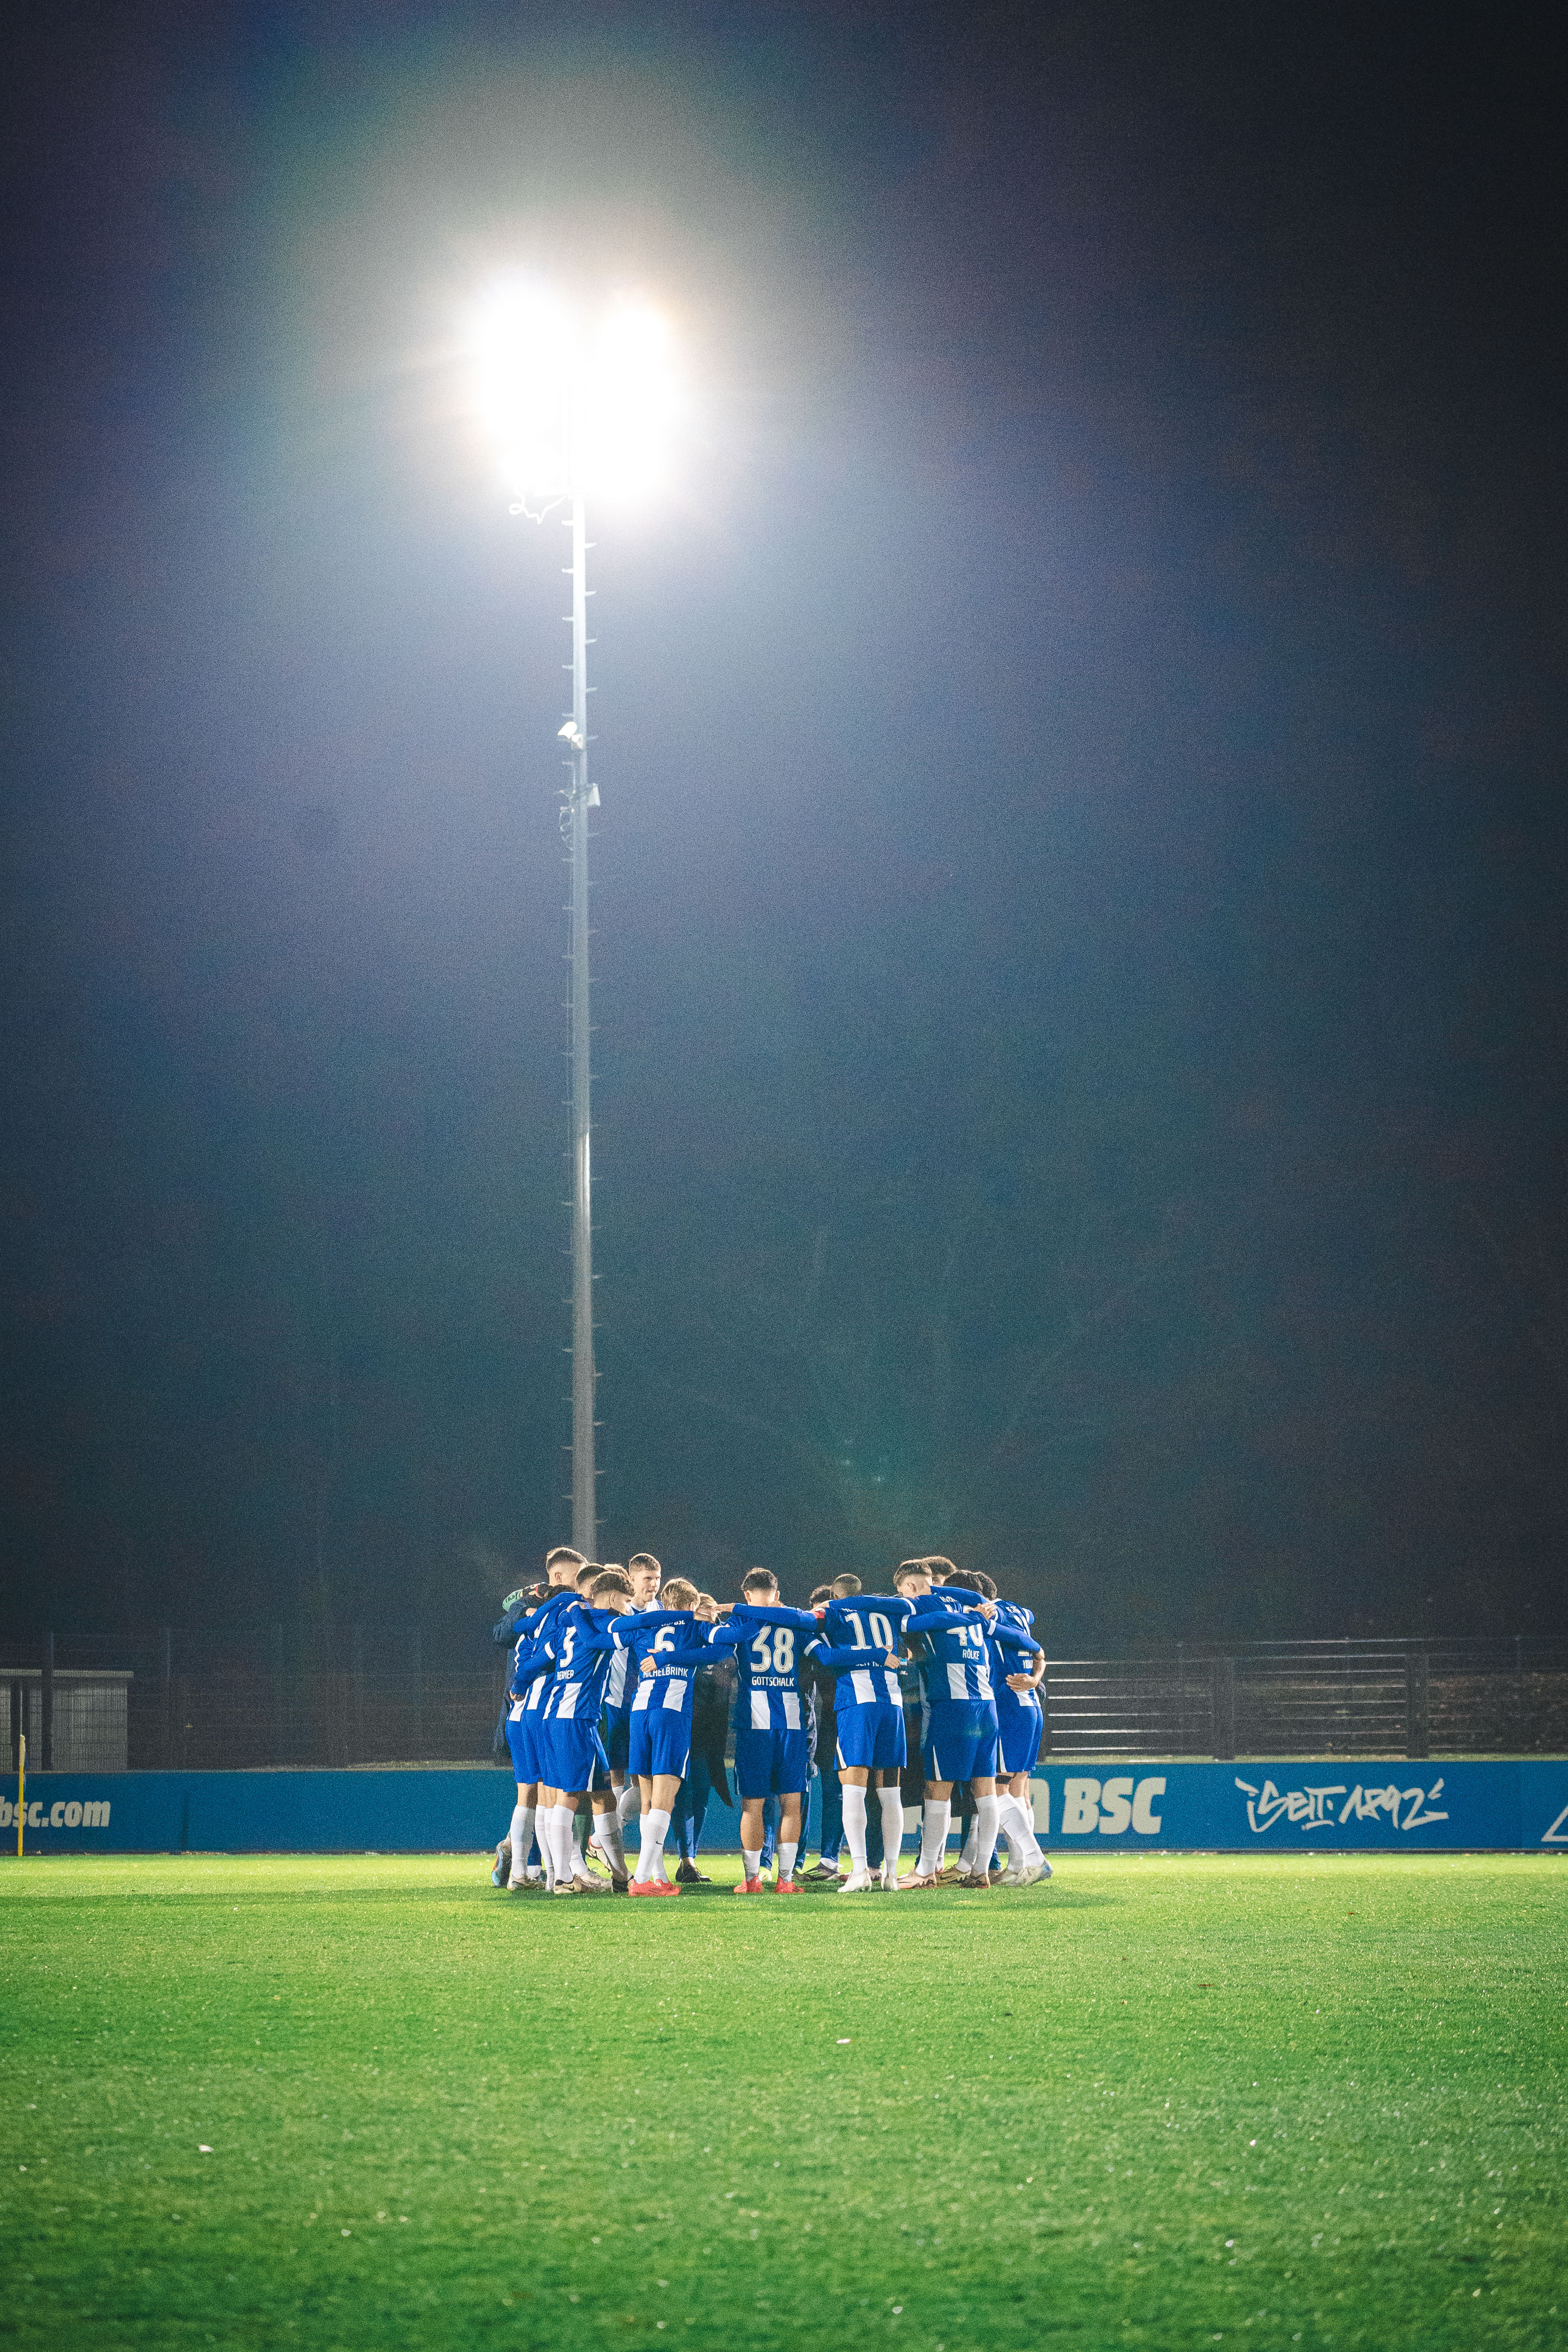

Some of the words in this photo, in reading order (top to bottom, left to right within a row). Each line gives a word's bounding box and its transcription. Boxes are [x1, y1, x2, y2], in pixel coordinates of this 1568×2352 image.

[654, 1626, 675, 1652] 6
[845, 1612, 893, 1652] 10
[750, 1626, 794, 1673] 38
[963, 1648, 980, 1660] RÖLKE
[557, 1669, 574, 1681] BERNER
[752, 1676, 794, 1687] GOTTSCHALK
[1062, 1777, 1167, 1834] BSC
